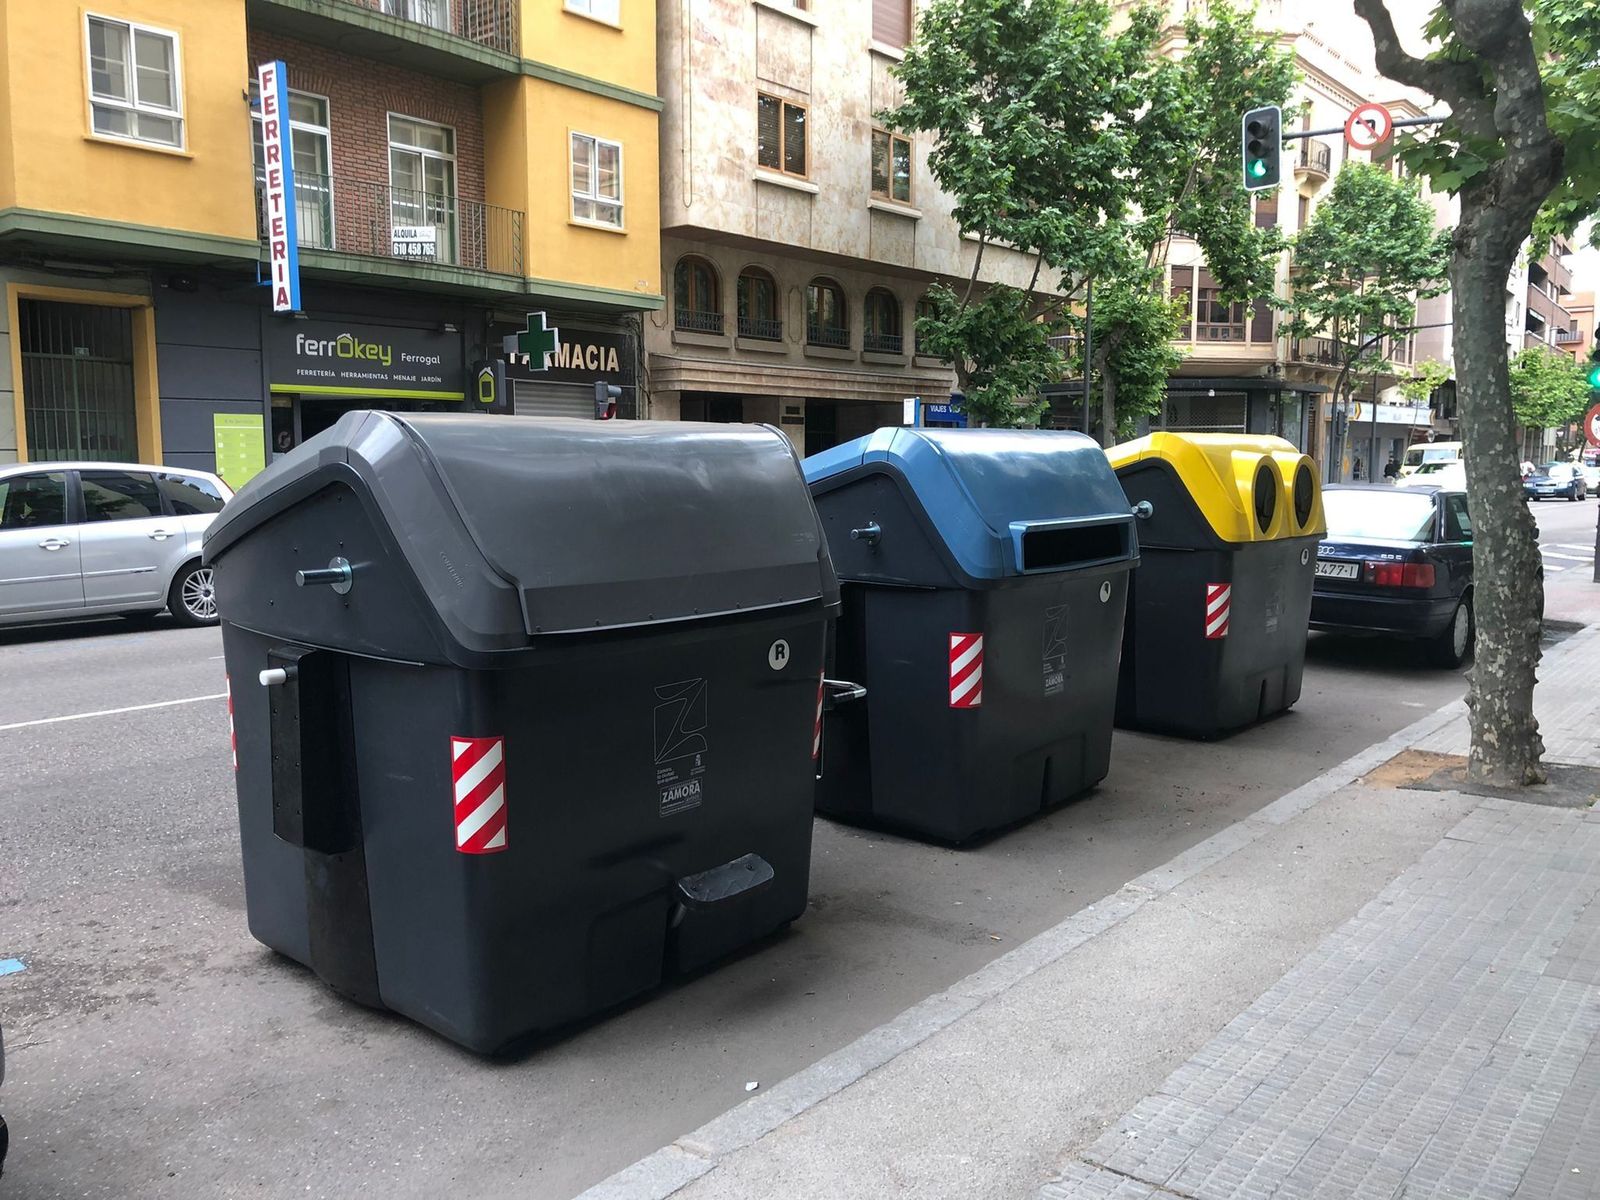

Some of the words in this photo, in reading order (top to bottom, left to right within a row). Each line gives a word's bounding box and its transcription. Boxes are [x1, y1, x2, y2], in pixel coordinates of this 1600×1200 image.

[262, 70, 290, 306] FERRETERIA
[393, 229, 418, 239] ALQUILA
[393, 243, 407, 255] 610
[408, 243, 422, 255] 458
[401, 353, 441, 365] Ferrogal
[509, 341, 620, 372] MACIA
[297, 368, 336, 377] FERRETERÍA
[340, 371, 389, 380] HERRAMIENTAS
[393, 374, 417, 382] MENAJE
[421, 375, 442, 383] JARDÍN
[930, 405, 947, 413] VIAJES
[775, 643, 785, 660] R
[662, 782, 701, 803] ZAMORA
